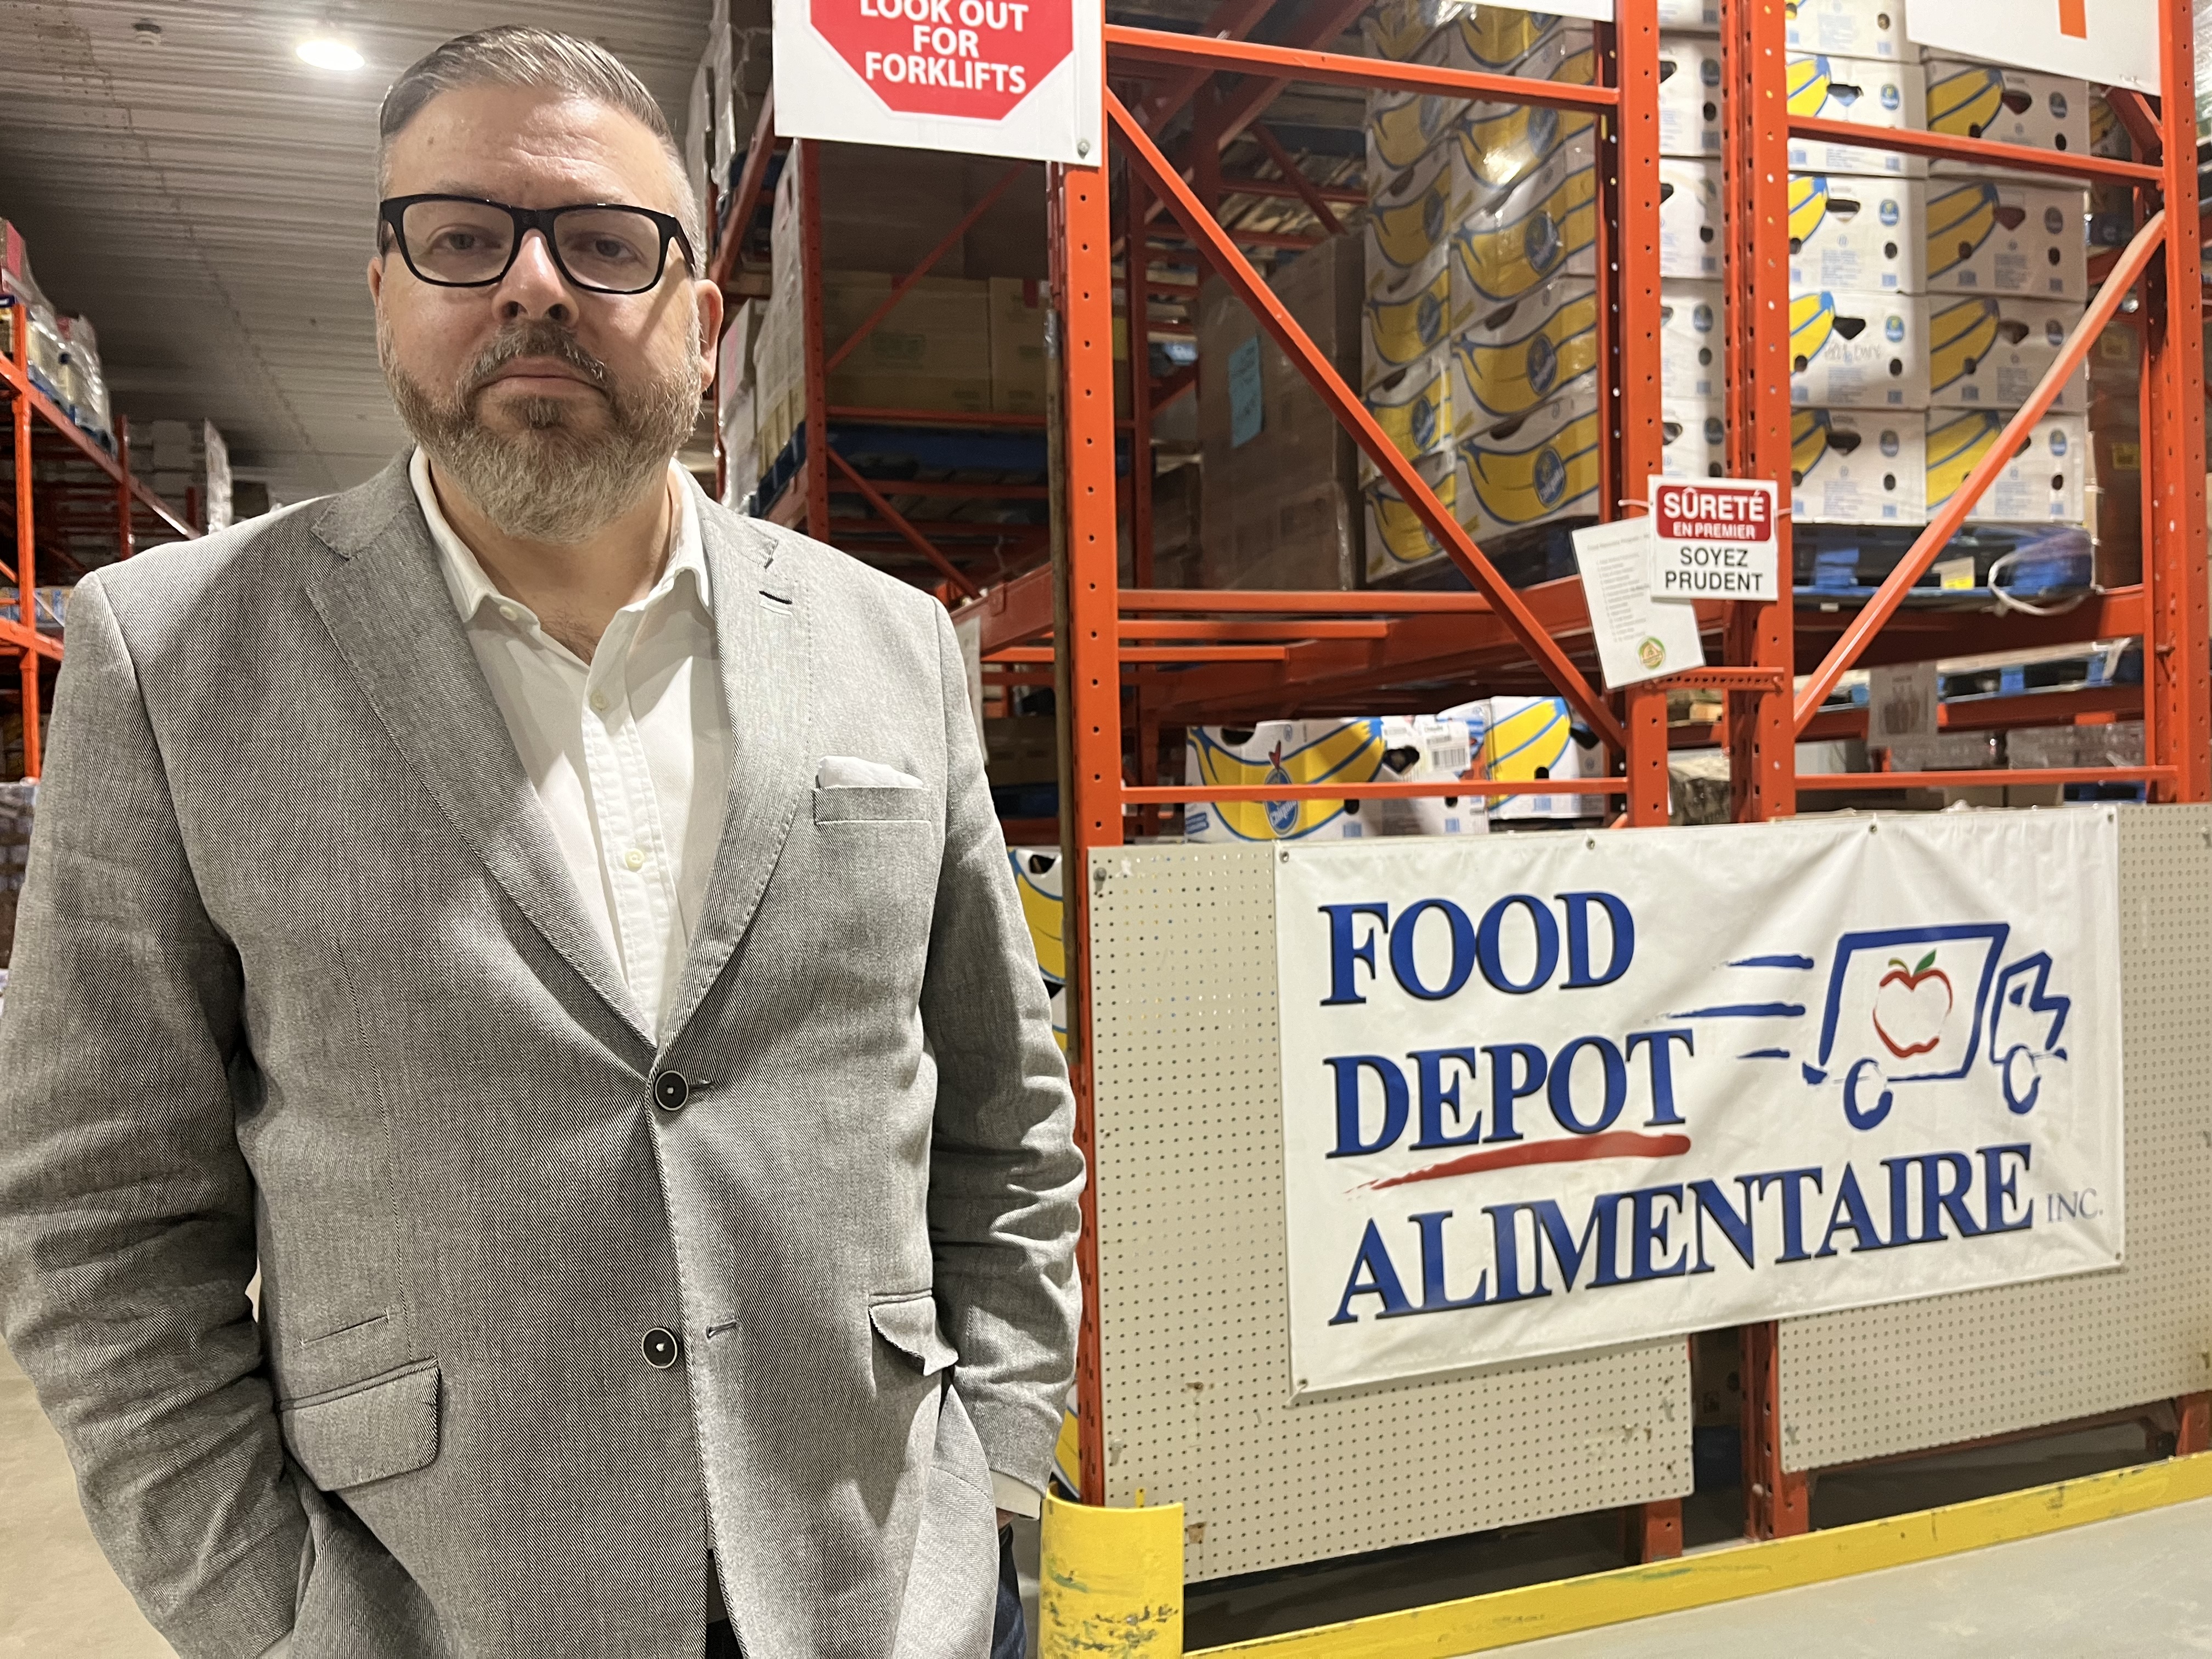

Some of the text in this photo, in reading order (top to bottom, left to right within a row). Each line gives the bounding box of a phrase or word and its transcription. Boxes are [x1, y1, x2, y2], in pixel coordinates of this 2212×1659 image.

[860, 0, 1029, 31] LOOK OUT
[913, 25, 980, 58] FOR
[865, 51, 1026, 94] FORKLIFTS
[1663, 486, 1765, 522] SÛRETÉ
[1673, 521, 1756, 540] EN PREMIER
[1680, 546, 1748, 567] SOYEZ
[1665, 571, 1763, 591] PRUDENT
[1319, 892, 1635, 1006] FOOD
[1324, 1029, 1694, 1159] DEPOT
[1329, 1144, 2104, 1326] ALIMENTAIRE INC.
